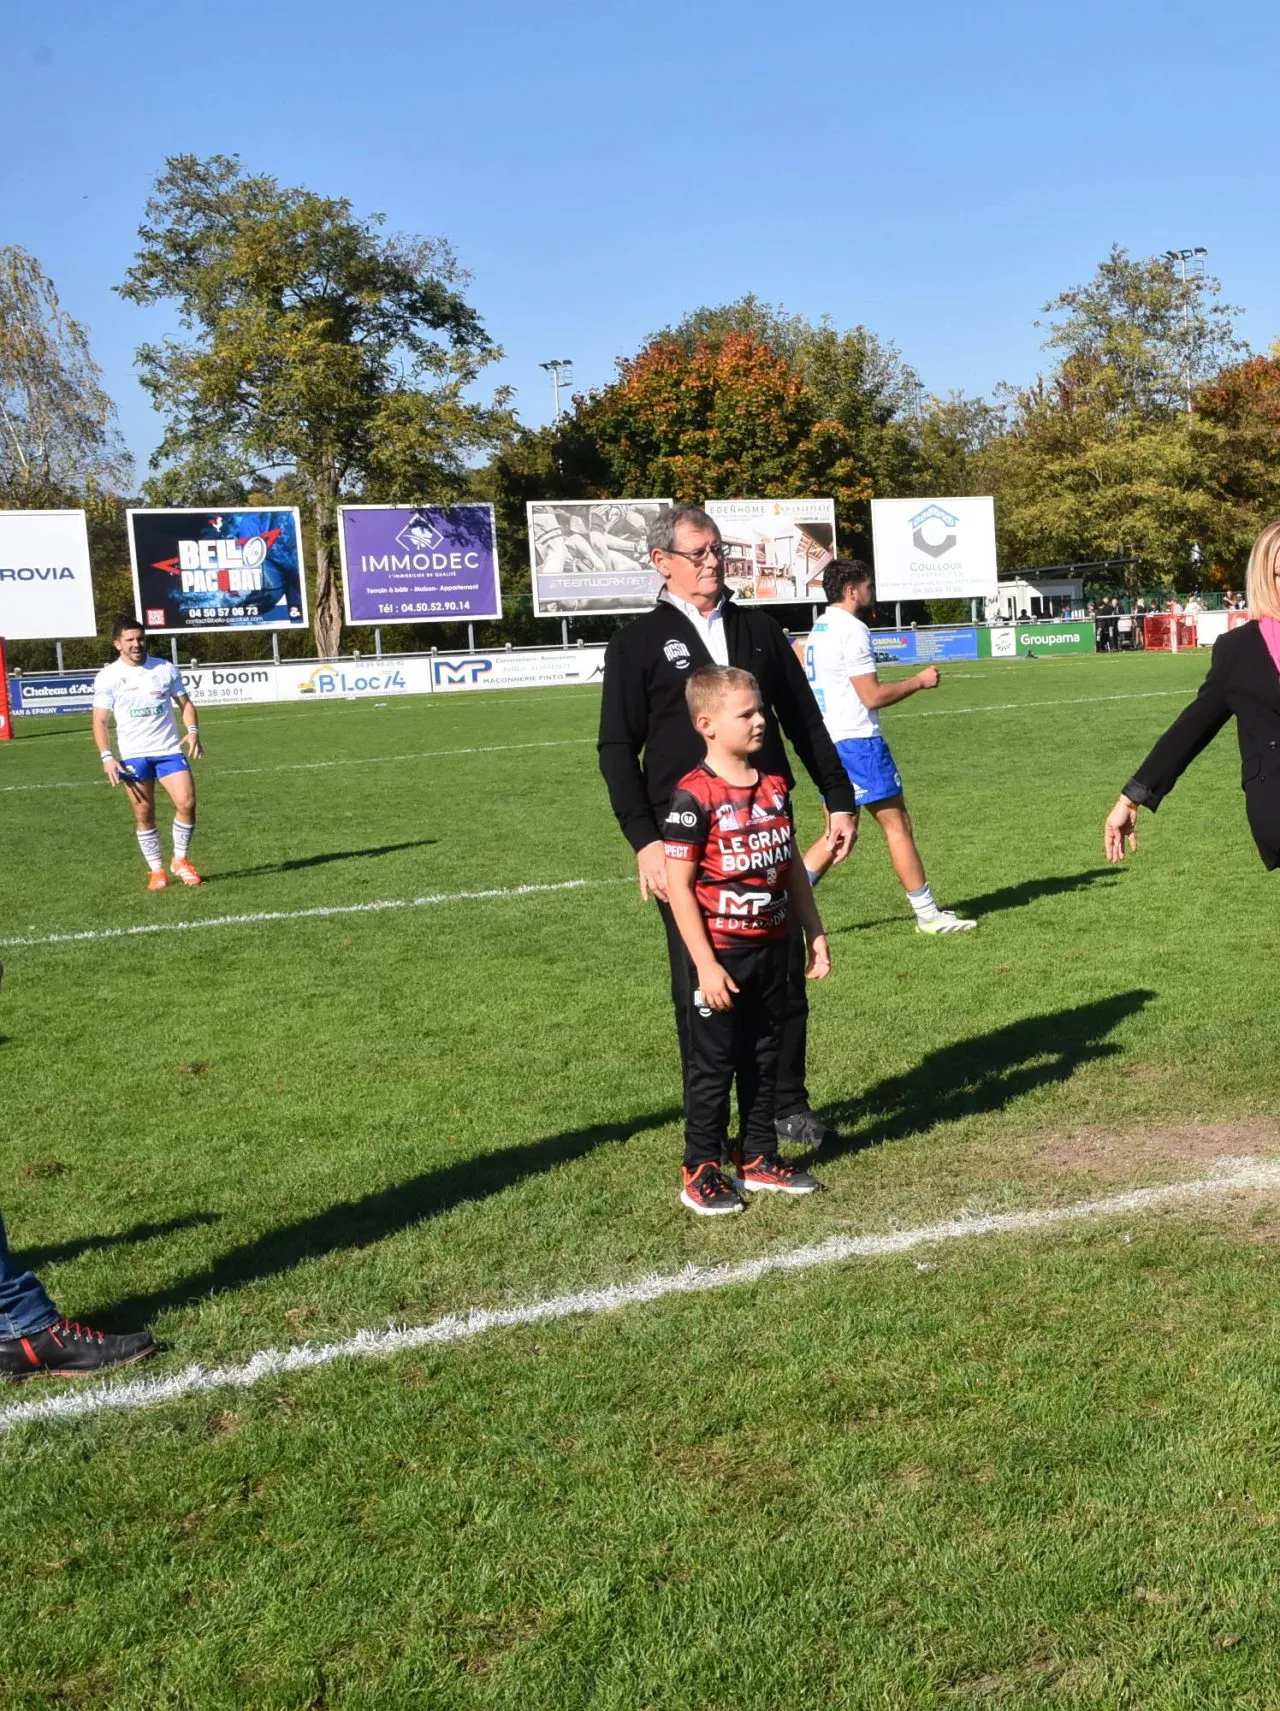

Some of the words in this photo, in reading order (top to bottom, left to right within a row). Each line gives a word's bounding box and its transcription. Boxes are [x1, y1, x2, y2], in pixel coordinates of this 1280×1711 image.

[178, 536, 267, 570] BELLO
[361, 552, 480, 572] IMMODEC
[181, 568, 263, 593] PACOBAT
[440, 584, 479, 592] Appartement
[189, 608, 201, 618] 04
[203, 607, 216, 617] 50
[218, 607, 230, 616] 57
[246, 606, 259, 615] 73
[378, 603, 393, 614] Tél
[401, 601, 470, 613] 04.50.52.90.14
[1020, 633, 1080, 646] Groupama
[212, 670, 269, 685] boom
[433, 658, 493, 686] MP
[539, 672, 563, 681] PINTO
[23, 684, 68, 697] Chateau
[220, 688, 230, 696] 30
[233, 688, 243, 696] 01
[31, 707, 57, 715] EPAGNY
[718, 836, 745, 854] LE
[718, 889, 772, 916] MP
